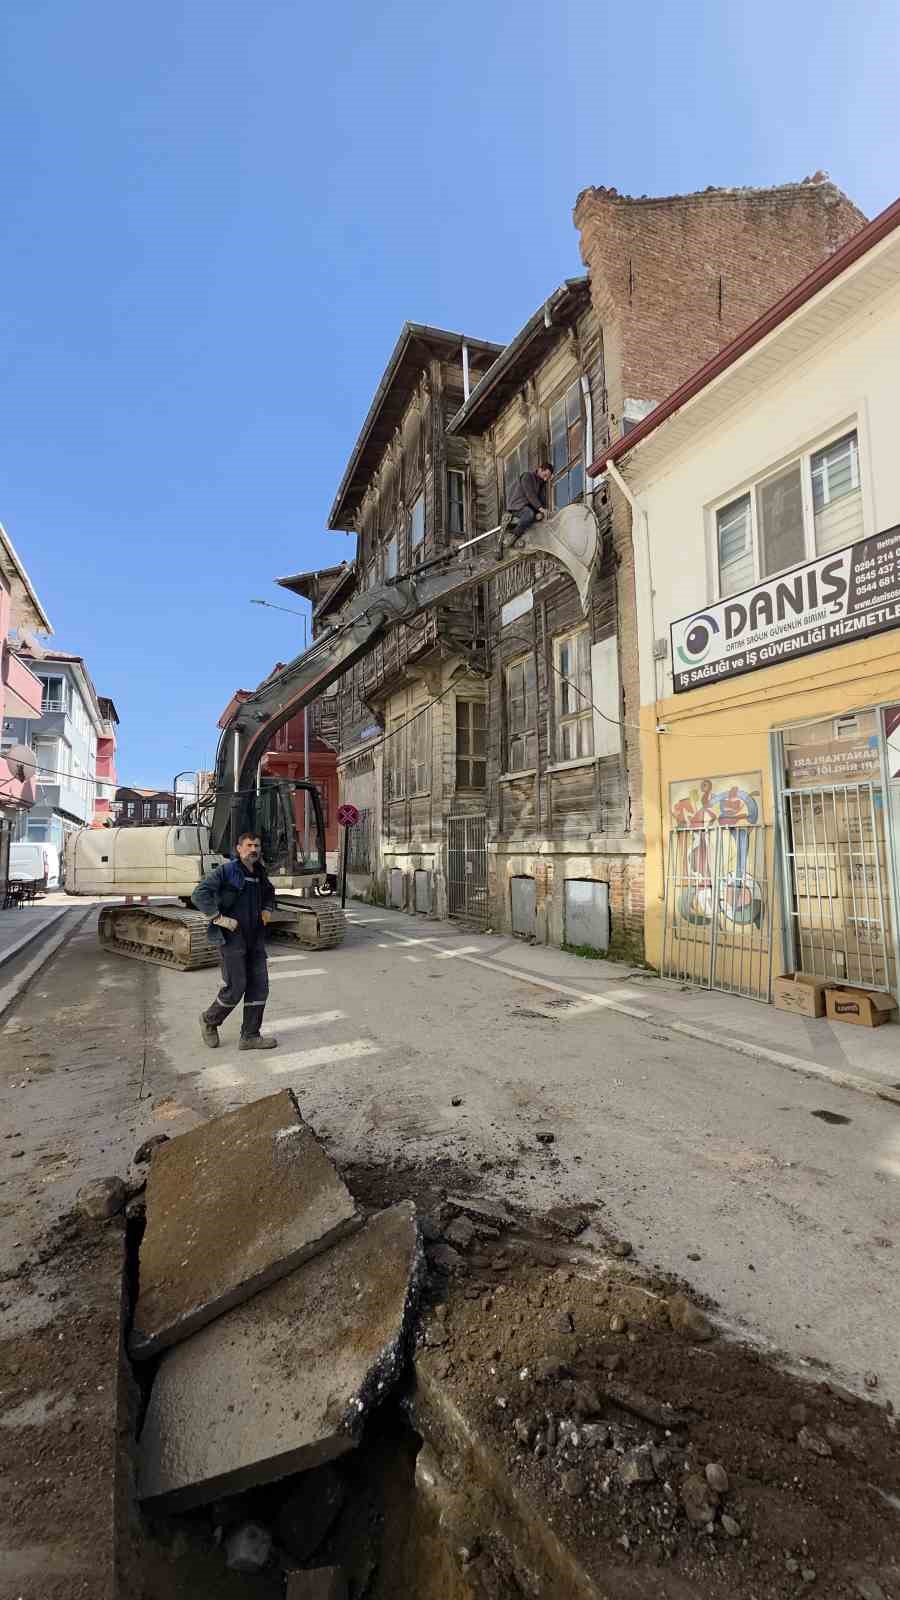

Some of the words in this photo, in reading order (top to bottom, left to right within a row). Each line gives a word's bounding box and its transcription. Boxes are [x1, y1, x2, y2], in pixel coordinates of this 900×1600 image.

[855, 570, 876, 584] 0545
[856, 581, 877, 596] 0544
[878, 575, 895, 588] 681
[724, 558, 848, 641] DANIŞ
[726, 639, 746, 652] ORTAK
[680, 673, 689, 688] İŞ
[691, 660, 730, 681] SAĞLIĞI
[731, 658, 745, 669] ve
[746, 650, 758, 665] İŞ
[759, 626, 826, 660] GÜVENLİĞİ
